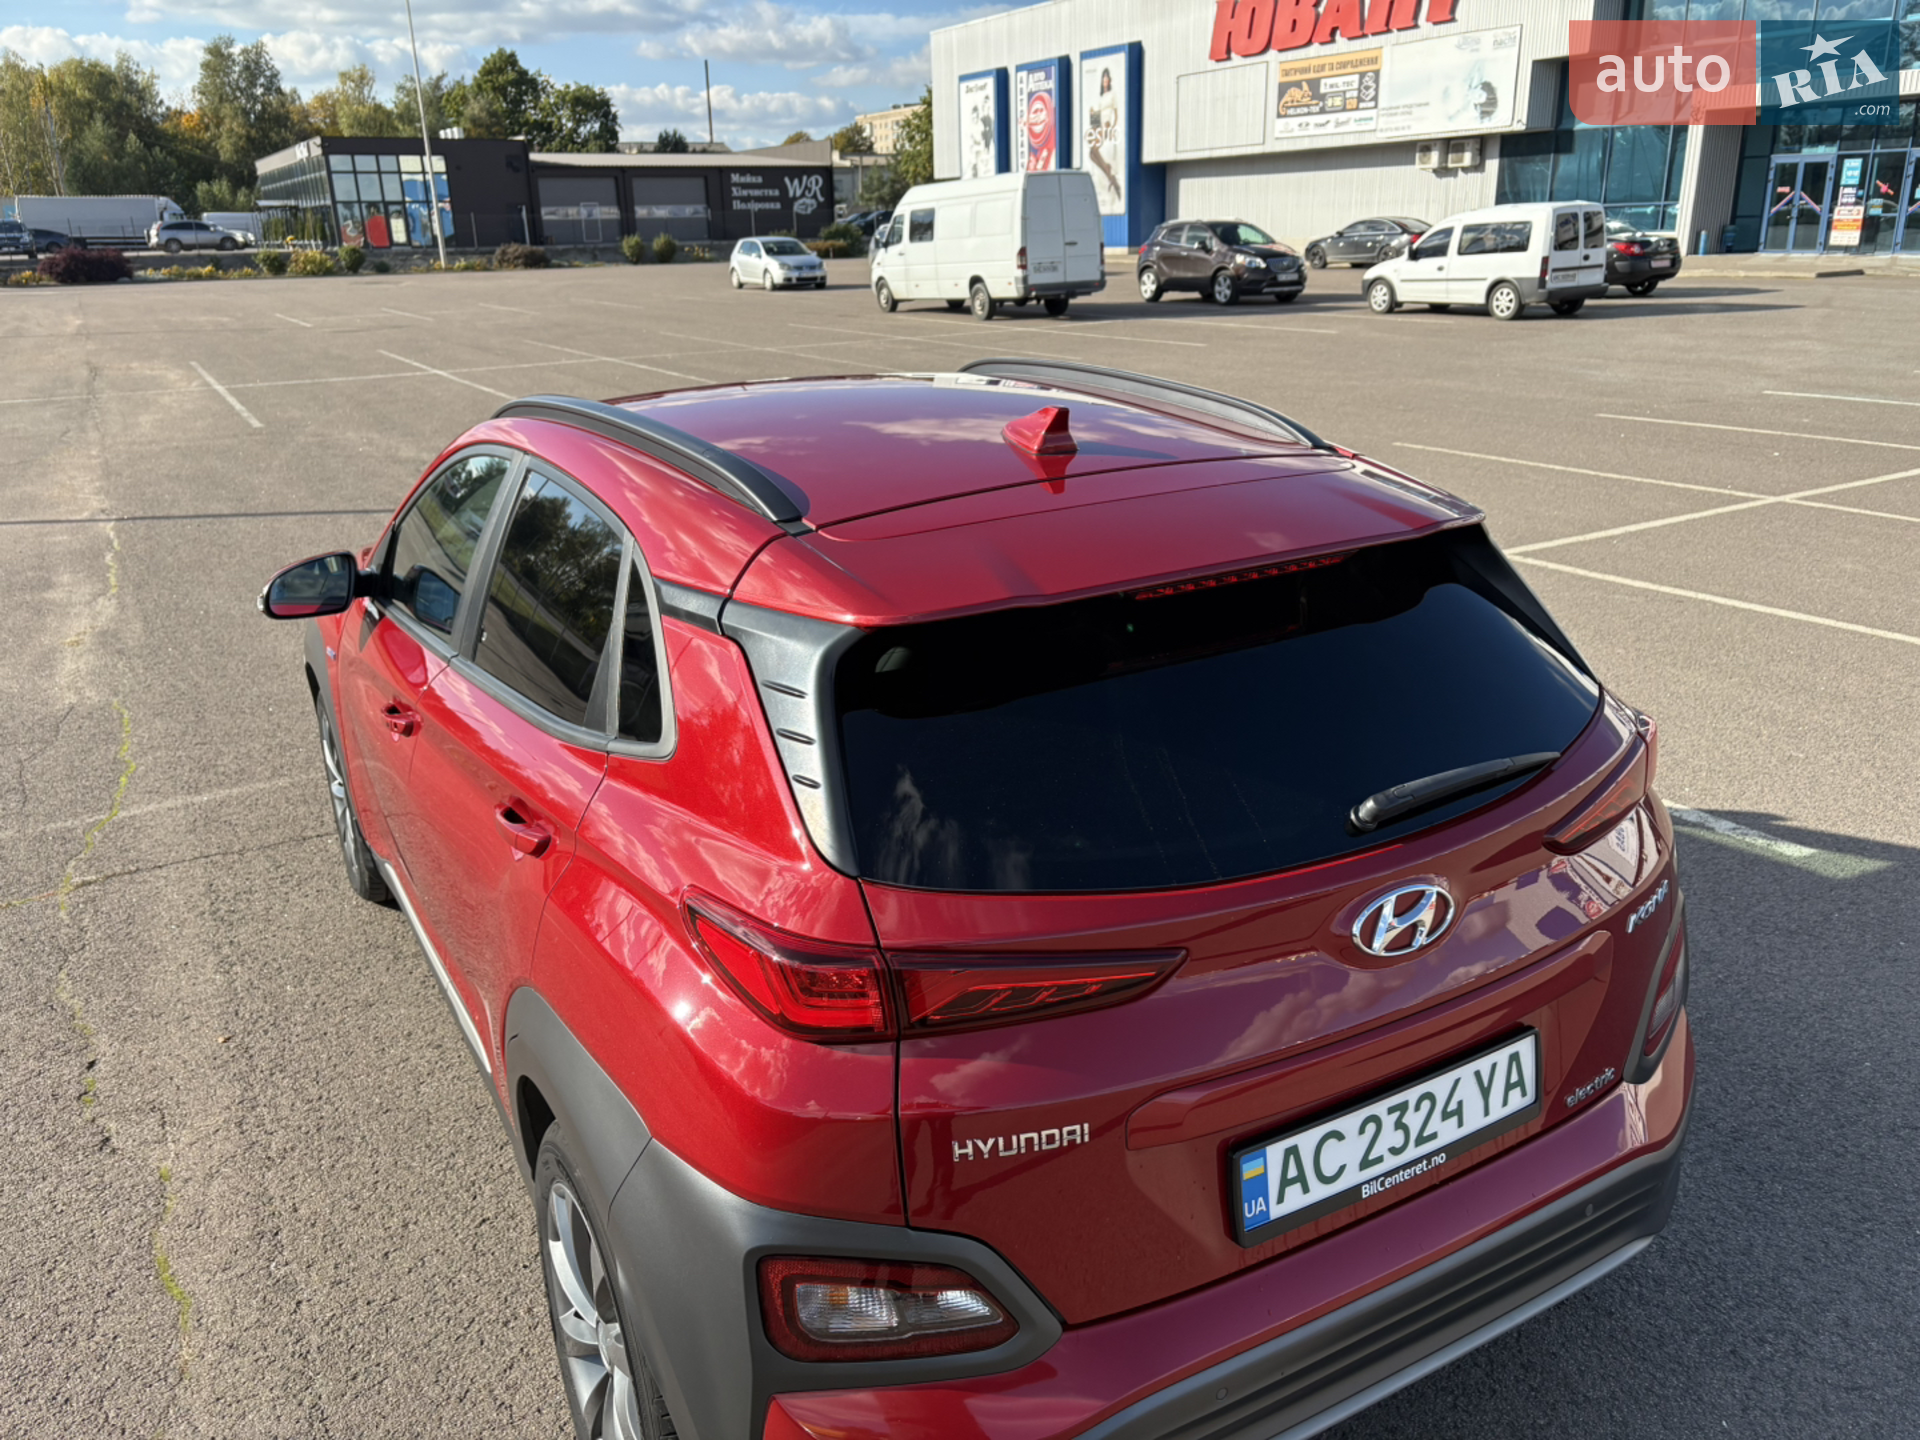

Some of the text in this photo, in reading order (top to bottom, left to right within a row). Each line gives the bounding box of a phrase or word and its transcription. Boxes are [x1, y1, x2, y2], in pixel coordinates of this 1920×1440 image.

[730, 173, 763, 184] Мийка
[731, 186, 780, 197] Хімчистка
[784, 174, 825, 203] WR
[732, 200, 782, 212] Поліровка
[1565, 1067, 1615, 1108] electric
[952, 1122, 1090, 1162] HYUNDAI
[1276, 1051, 1528, 1205] AC 2324 YA
[1361, 1152, 1446, 1199] BilCenteret.no
[1244, 1197, 1267, 1218] UA
